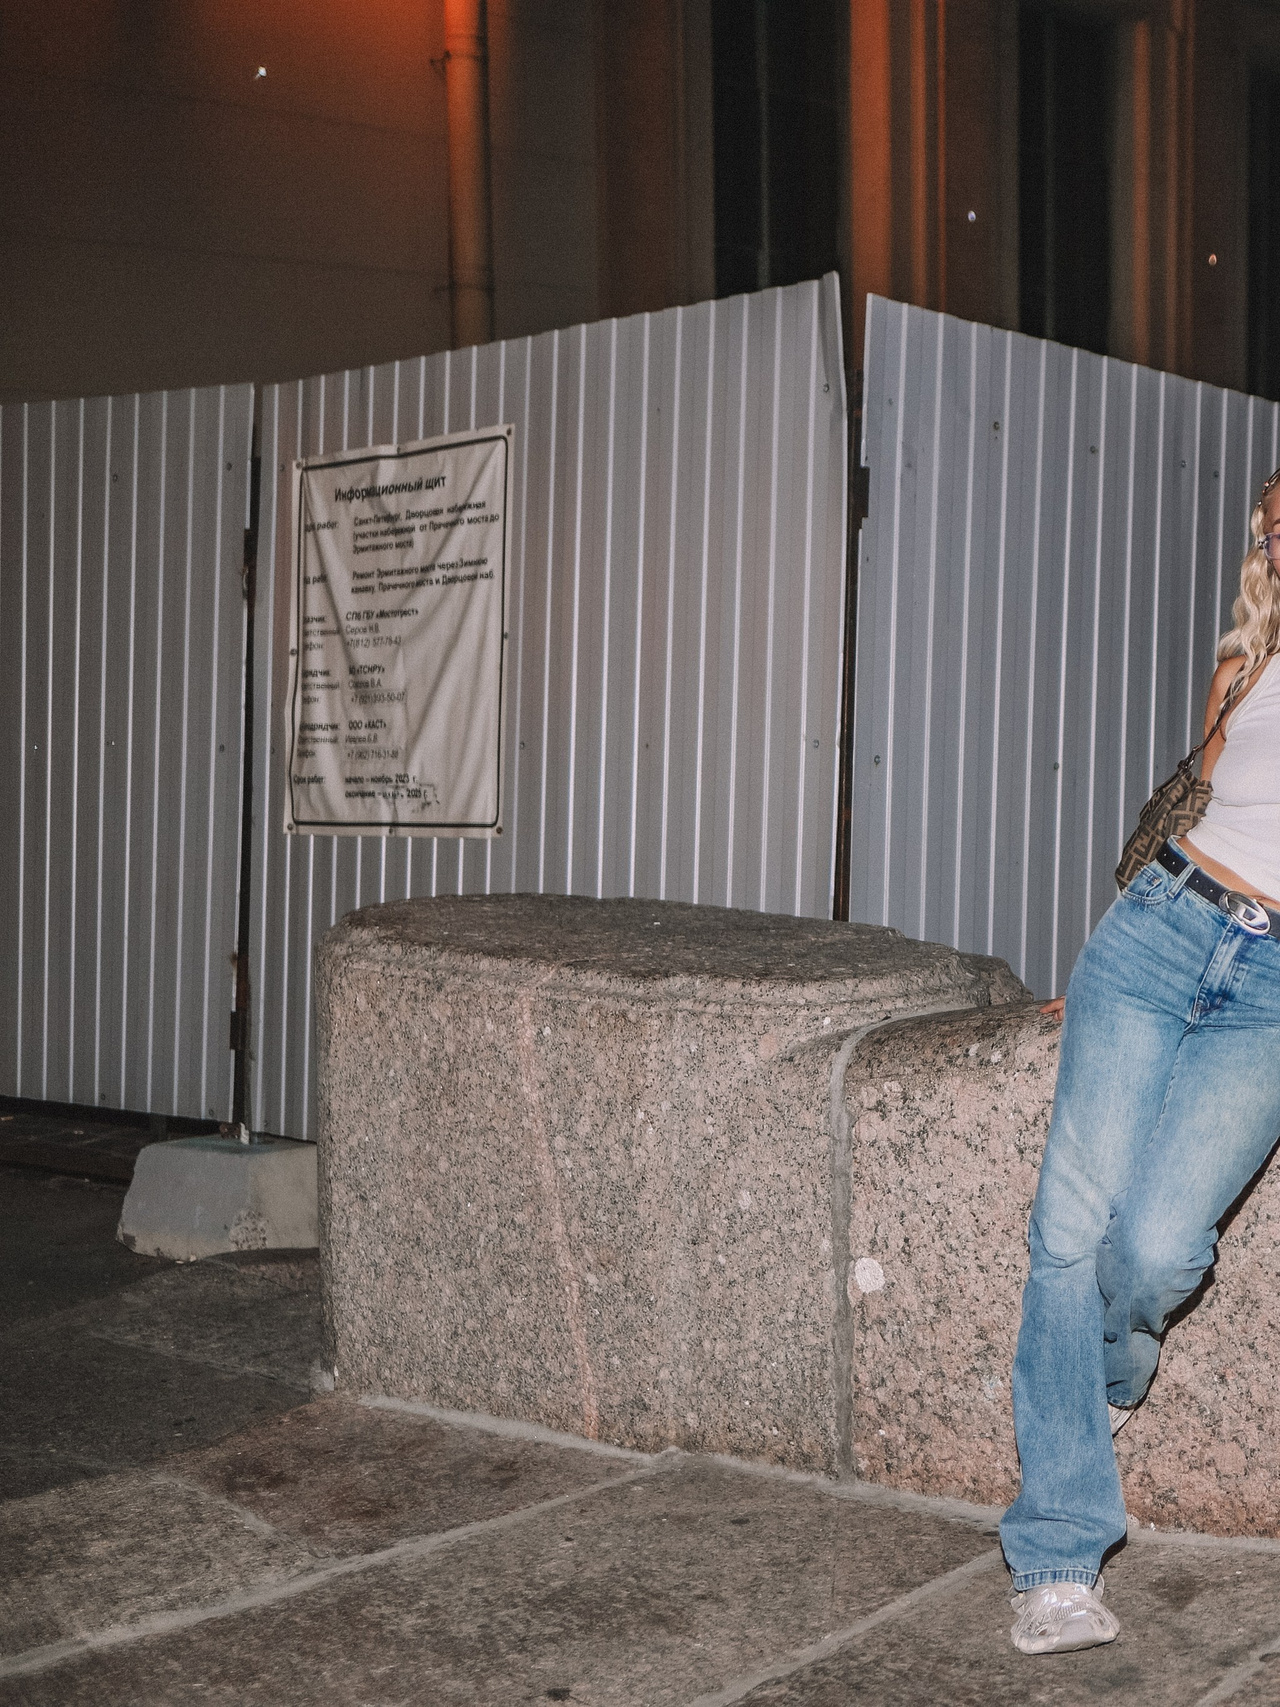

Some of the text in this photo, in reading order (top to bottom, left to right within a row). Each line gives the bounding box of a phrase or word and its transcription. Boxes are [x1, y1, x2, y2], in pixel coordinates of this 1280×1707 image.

[335, 476, 446, 503] Информационный щит
[420, 523, 427, 533] от
[467, 514, 489, 525] моста
[490, 512, 500, 523] до
[437, 561, 459, 571] через
[435, 577, 440, 586] и
[349, 720, 363, 730] ООО
